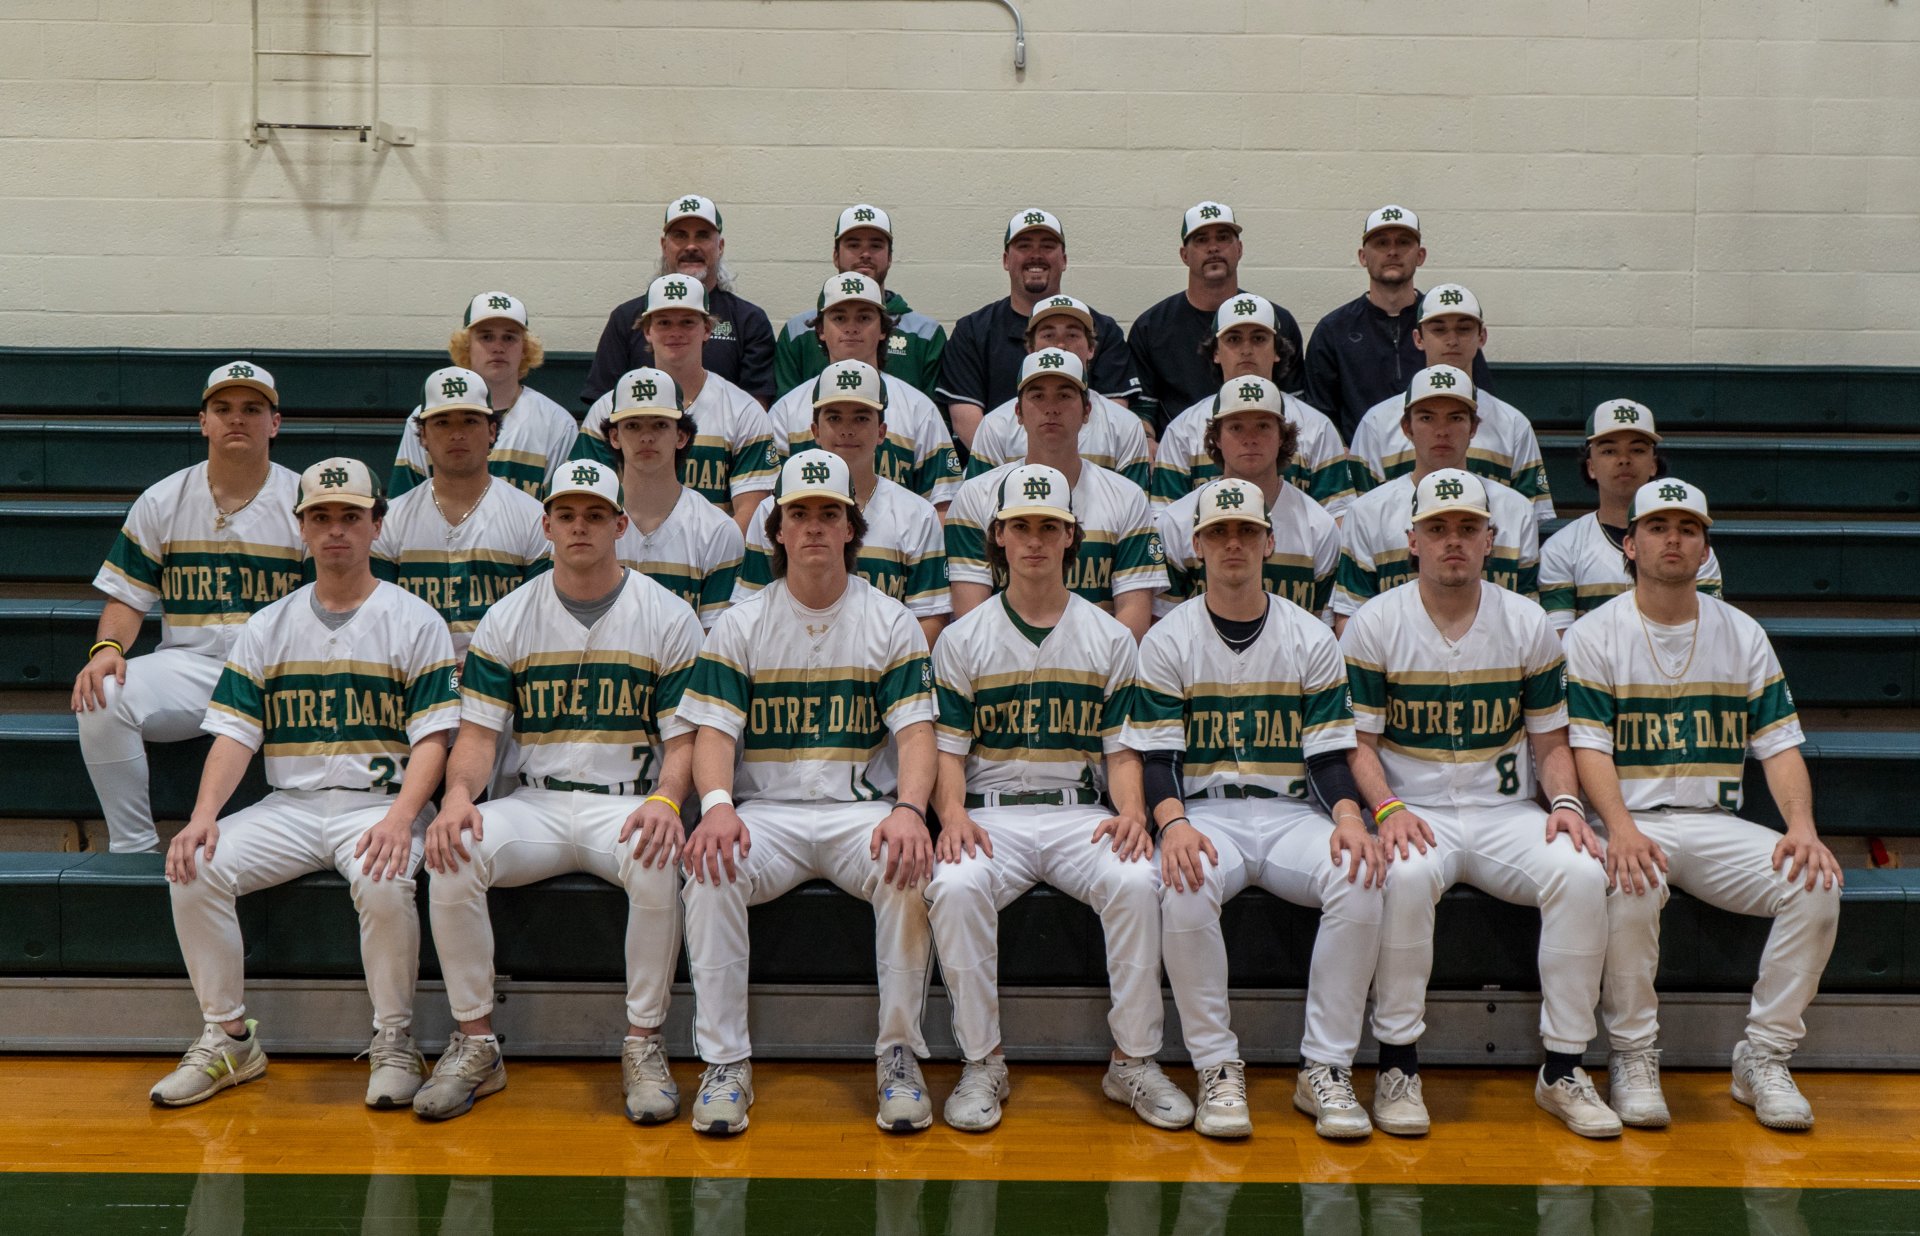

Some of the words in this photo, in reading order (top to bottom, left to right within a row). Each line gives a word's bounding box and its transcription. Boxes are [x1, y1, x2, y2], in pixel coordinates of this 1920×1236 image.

[1066, 556, 1112, 589] DAM
[750, 696, 820, 735] OTRE
[1616, 712, 1686, 751] OTRE
[1496, 752, 1520, 796] 8
